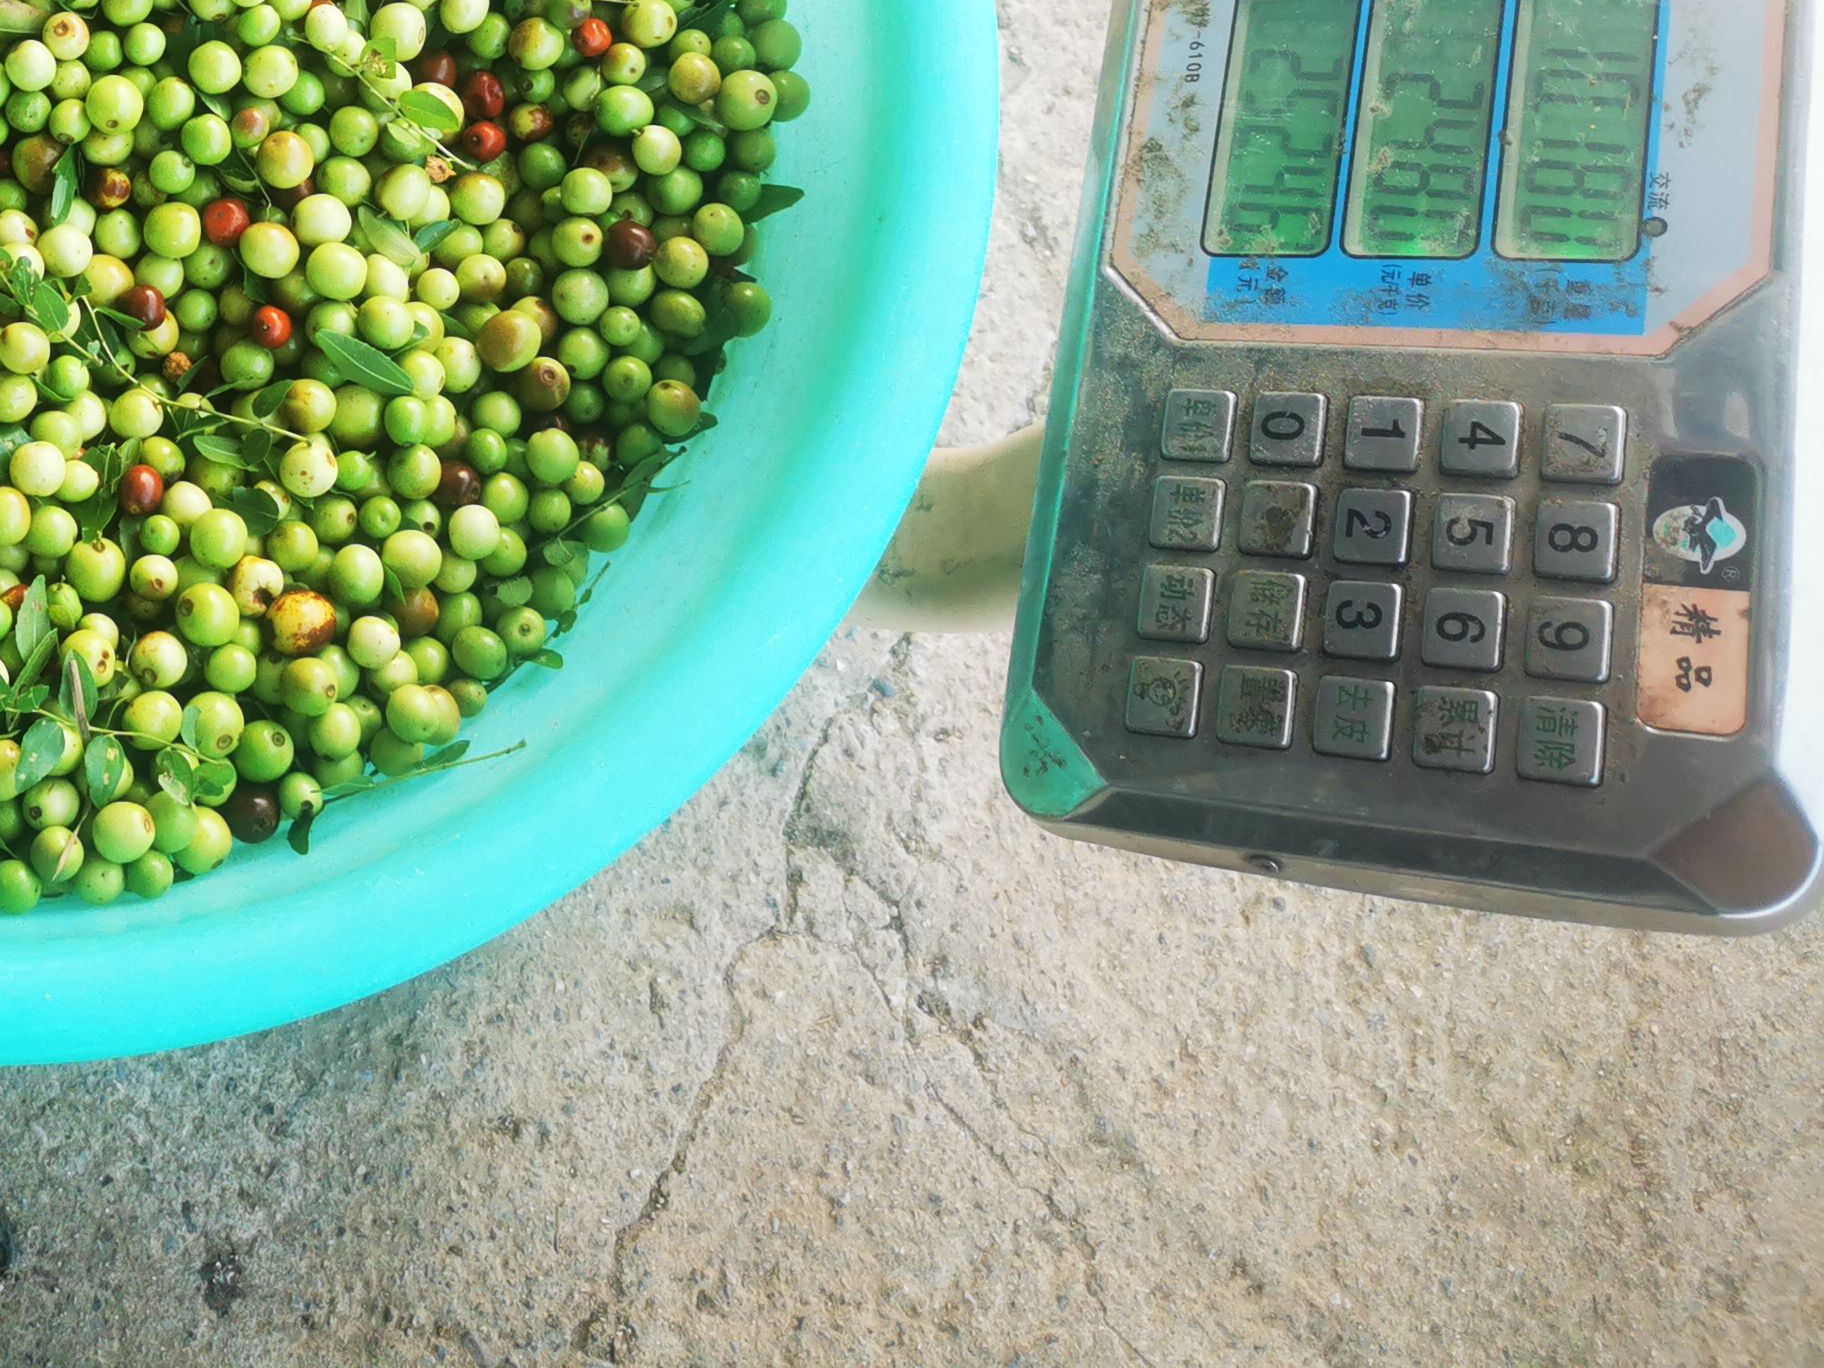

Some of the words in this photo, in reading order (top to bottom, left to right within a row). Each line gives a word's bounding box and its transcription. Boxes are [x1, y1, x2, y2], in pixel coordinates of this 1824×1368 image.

[1646, 172, 1671, 210] 交流
[1406, 270, 1433, 312] 单价
[1260, 412, 1305, 440] 0
[1360, 419, 1407, 440] 1
[1458, 420, 1506, 450] 4
[1556, 427, 1606, 458] 7
[1346, 511, 1393, 540] 2
[1446, 519, 1493, 547] 5
[1547, 524, 1599, 553] 8
[1156, 572, 1195, 629] 动态
[1248, 579, 1289, 645] 储存
[1336, 600, 1384, 630] 3
[1435, 612, 1486, 643] 6
[1538, 622, 1589, 651] 9
[1669, 601, 1722, 693] 精品
[1332, 683, 1372, 741] 去皮
[1426, 696, 1481, 757] 累计
[1534, 705, 1580, 769] 清除
